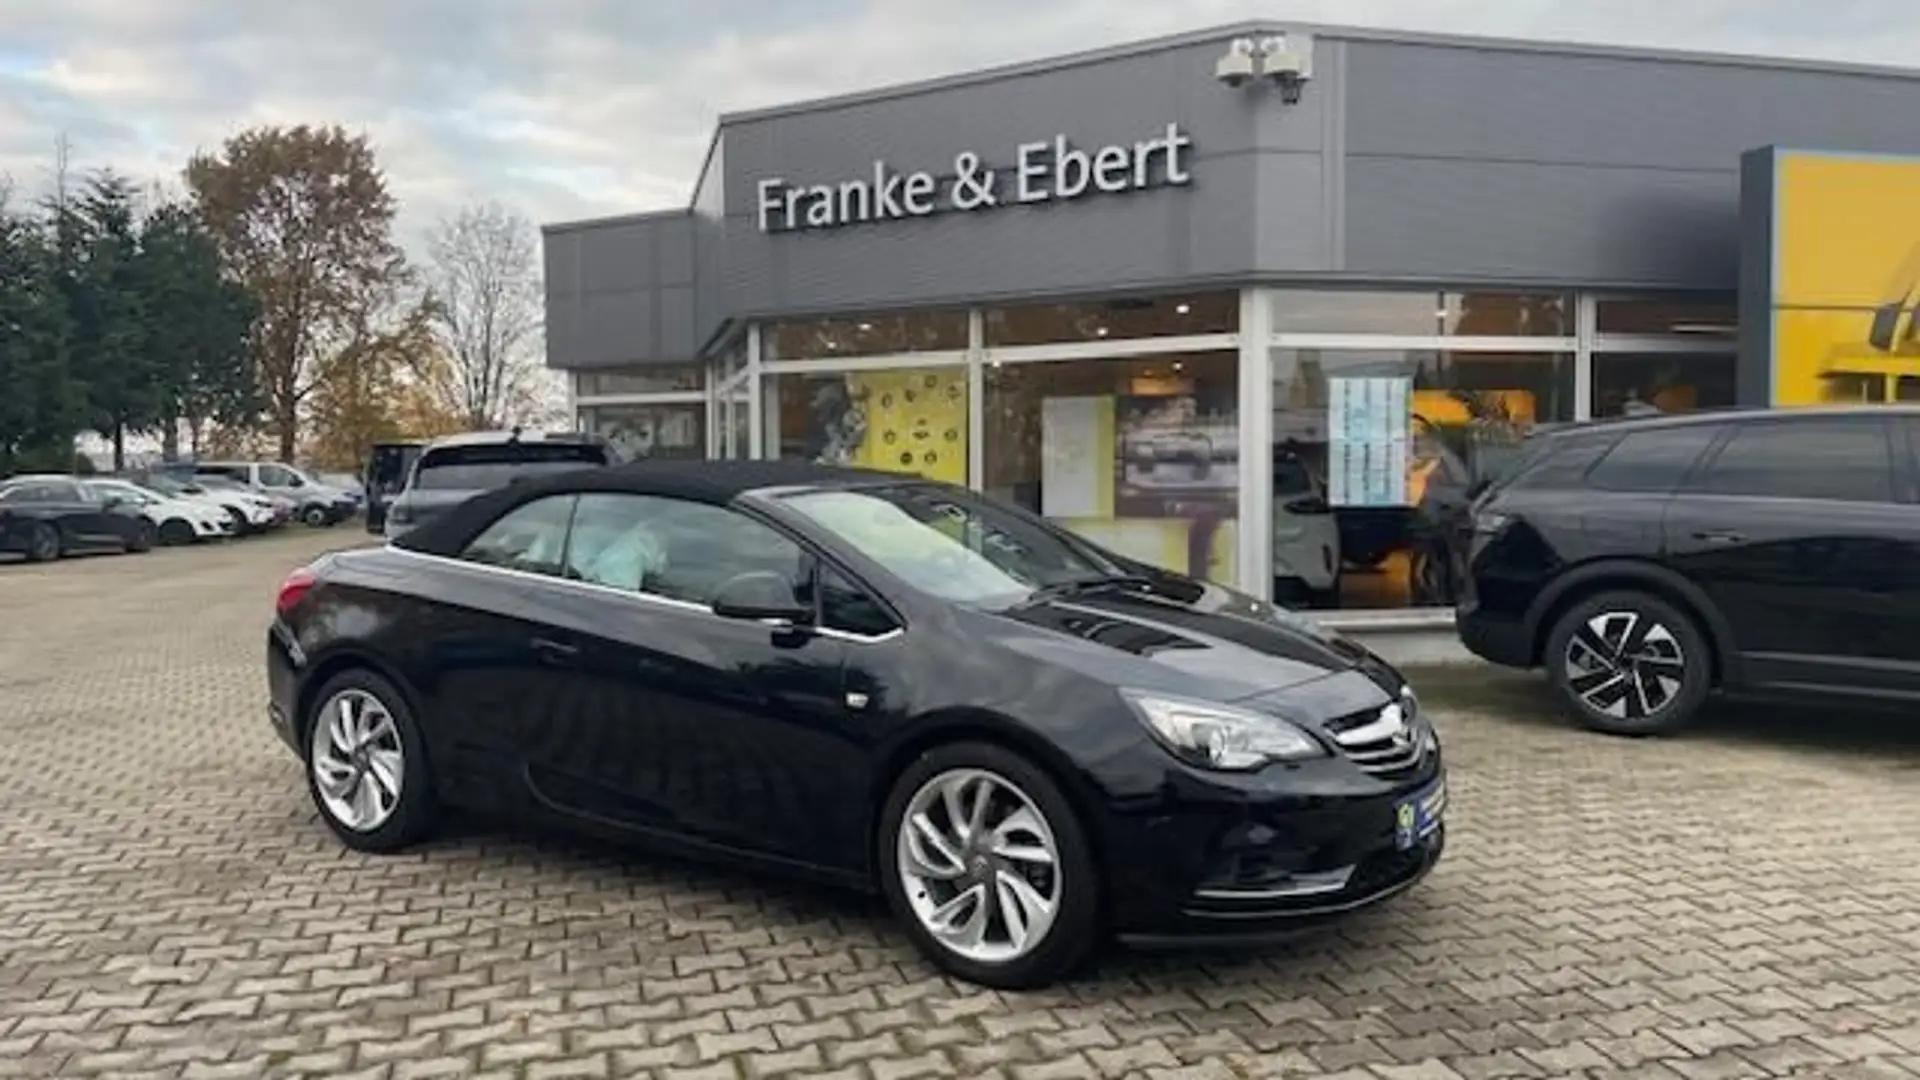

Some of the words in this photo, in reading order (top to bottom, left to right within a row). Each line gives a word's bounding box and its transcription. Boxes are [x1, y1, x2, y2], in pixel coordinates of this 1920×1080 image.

[757, 160, 934, 232] Franke
[951, 151, 996, 210] &
[1016, 122, 1190, 202] Ebert
